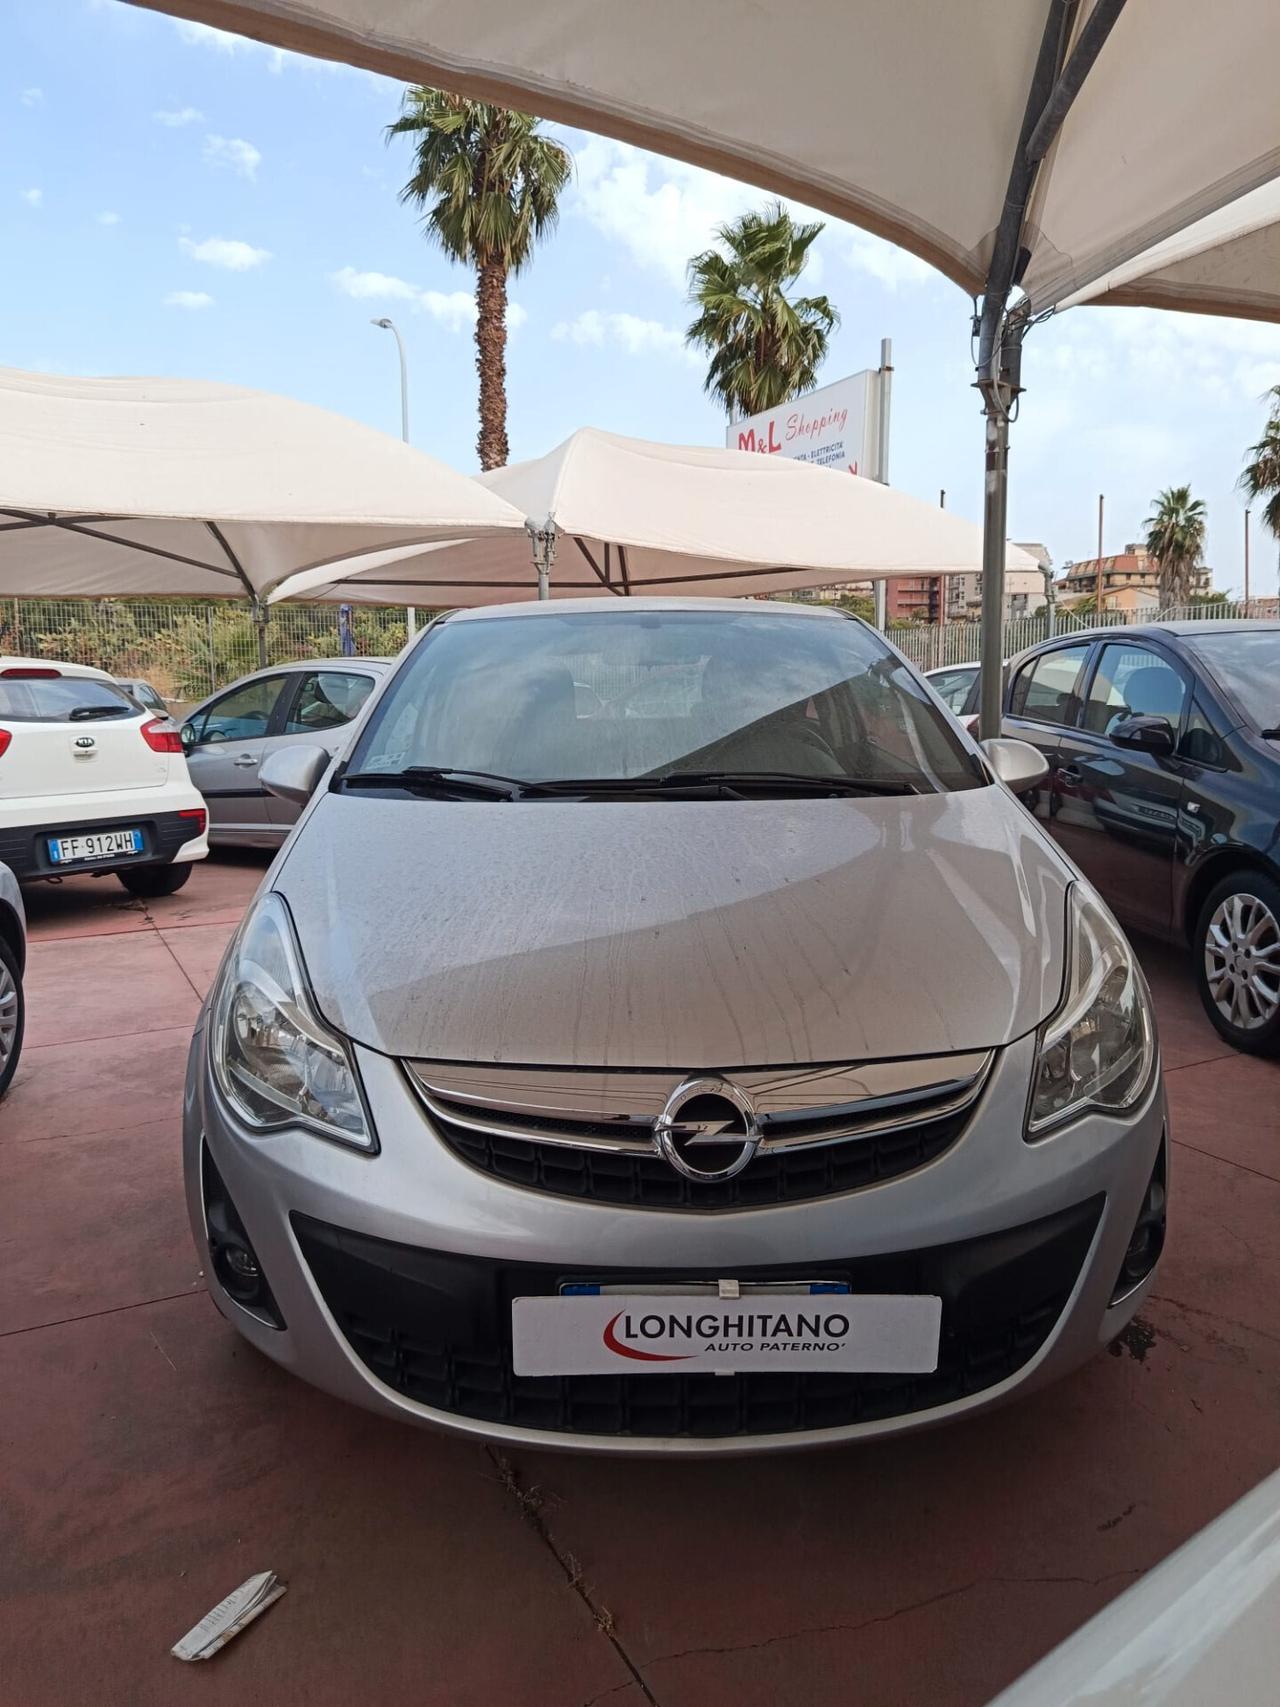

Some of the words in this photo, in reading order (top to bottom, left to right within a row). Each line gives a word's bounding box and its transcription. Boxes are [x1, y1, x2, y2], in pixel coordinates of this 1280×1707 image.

[739, 420, 782, 453] M&L
[785, 407, 848, 440] Shopping
[625, 1314, 849, 1339] LONGHITANO
[704, 1342, 754, 1352] AUTO
